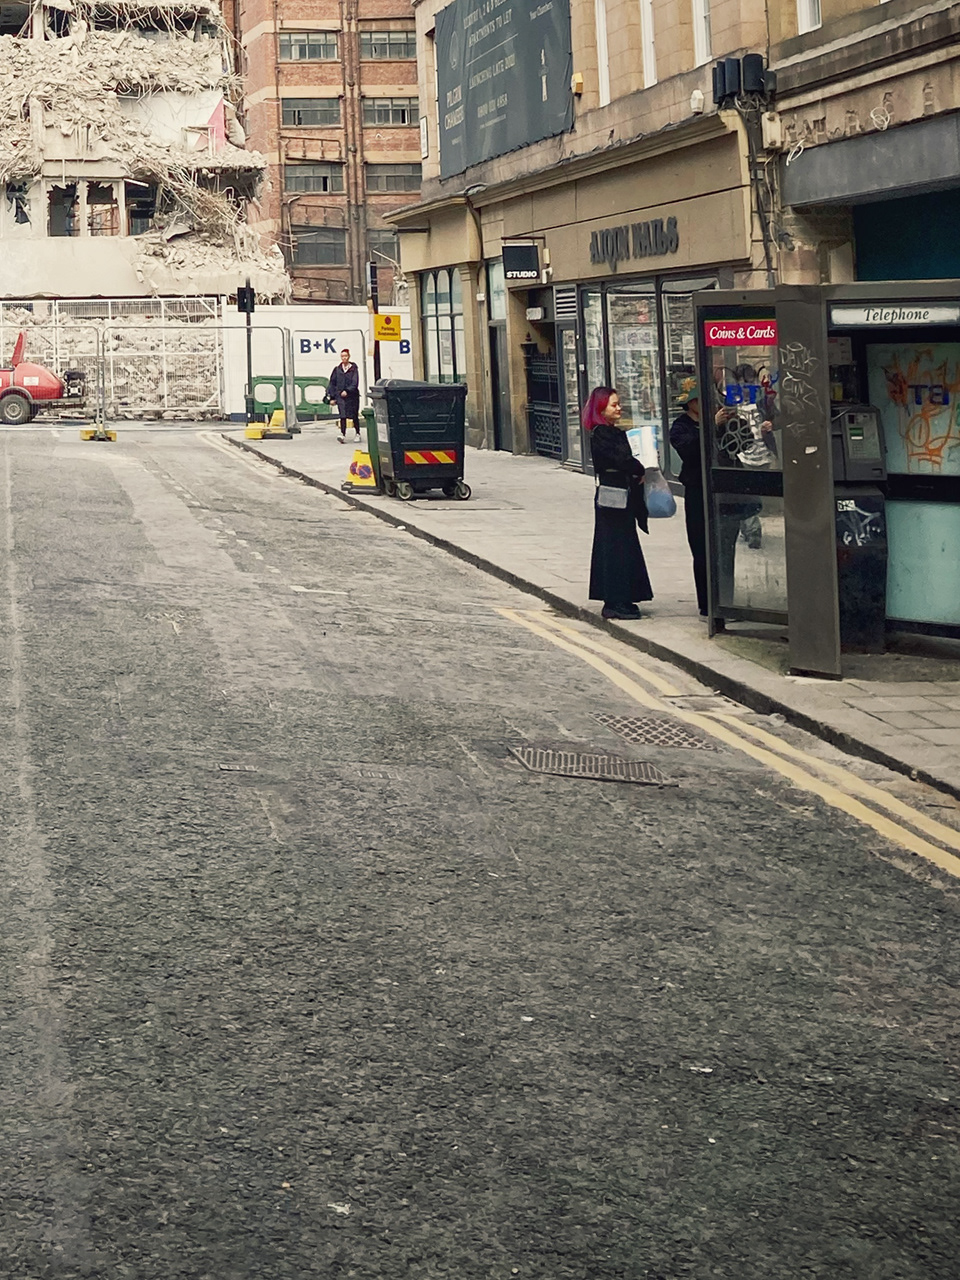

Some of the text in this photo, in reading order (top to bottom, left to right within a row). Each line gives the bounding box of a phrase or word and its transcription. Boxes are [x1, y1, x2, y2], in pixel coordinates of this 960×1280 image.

[503, 8, 512, 25] LET
[631, 216, 680, 260] NAILS
[506, 270, 538, 279] STUDIO
[863, 307, 930, 325] Telephone
[710, 324, 775, 340] Coins & Cards
[300, 338, 337, 354] B+K
[726, 383, 762, 406] BT
